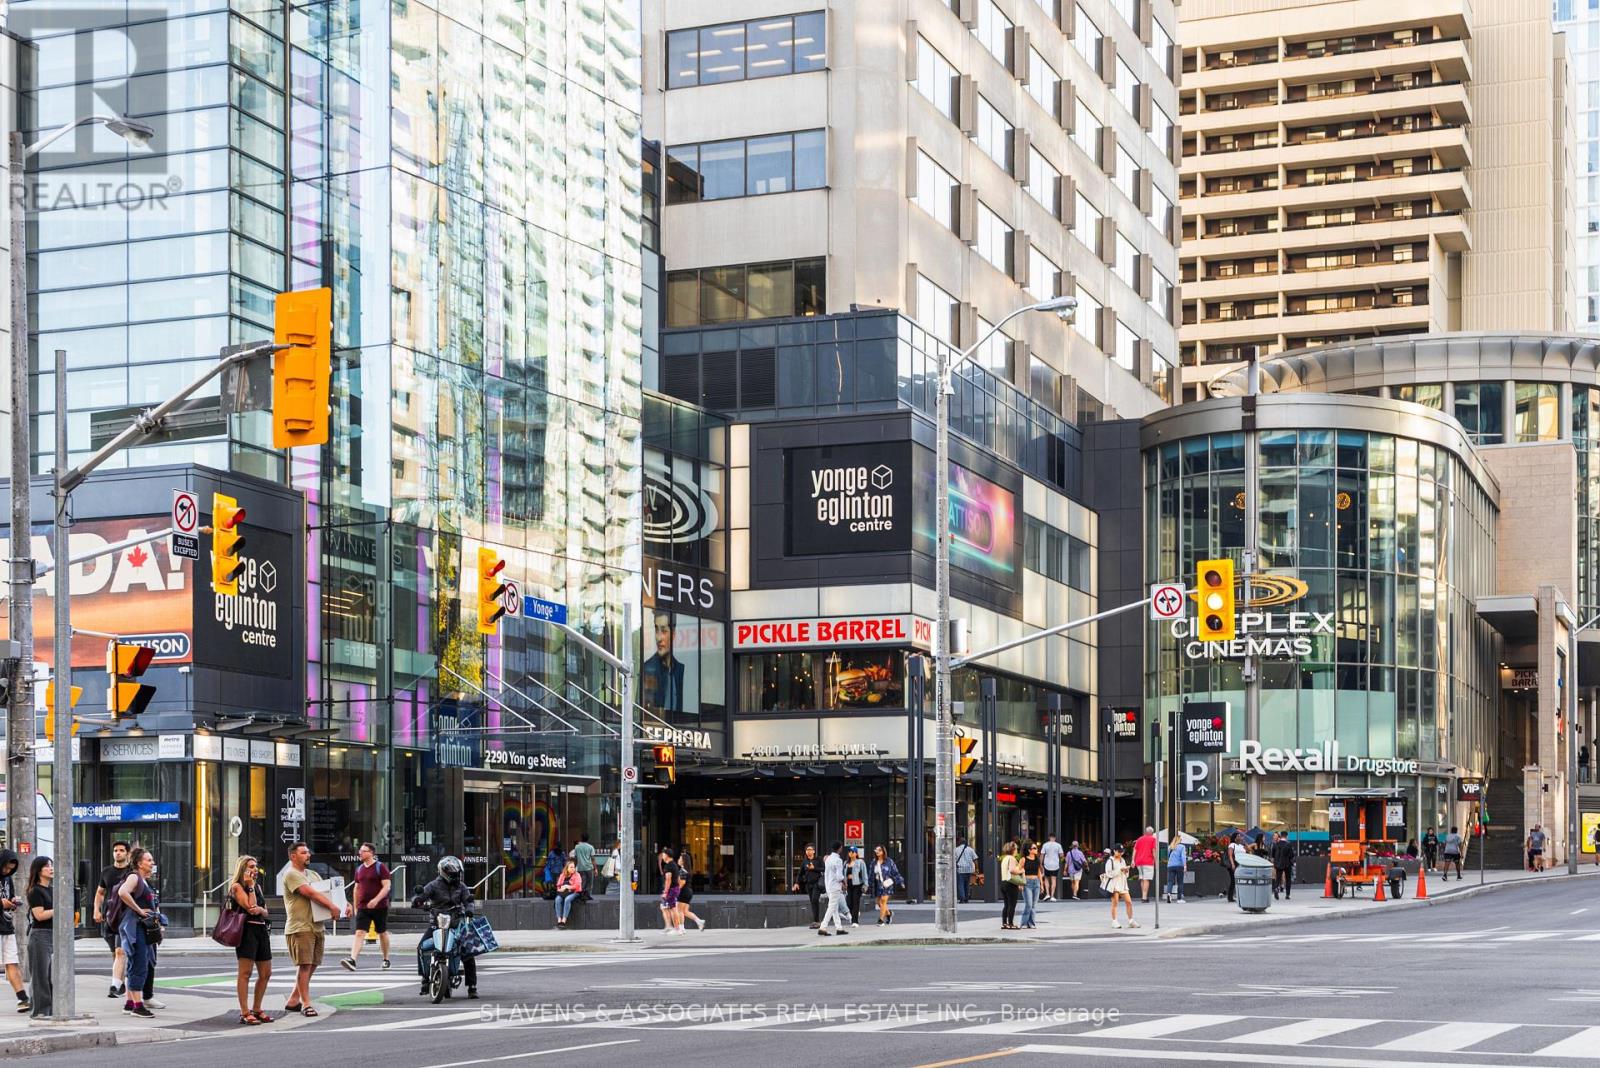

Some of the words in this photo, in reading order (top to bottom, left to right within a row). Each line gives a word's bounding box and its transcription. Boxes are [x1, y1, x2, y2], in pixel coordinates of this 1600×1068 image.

[811, 467, 868, 498] yonge
[817, 491, 893, 526] eglinton
[849, 518, 893, 532] centre
[177, 537, 194, 547] BUSES
[173, 545, 198, 557] EXCEPTED
[215, 592, 277, 630] eglinton
[532, 599, 554, 620] Yonge
[242, 630, 277, 648] centre
[738, 623, 810, 645] PICKLE
[817, 619, 906, 643] BARREL
[1186, 637, 1313, 659] CINEMAS
[1186, 718, 1212, 732] yonge
[645, 726, 712, 750] SEPHORA
[1189, 730, 1224, 744] eglinton
[112, 743, 154, 757] SERVICES
[751, 744, 780, 757] 2300
[787, 743, 826, 757] YONGE
[834, 743, 878, 756] TOWER
[484, 749, 508, 764] 2290
[539, 753, 567, 769] Street
[1240, 740, 1340, 775] Rexall
[1347, 755, 1418, 777] Drugstore
[1186, 760, 1209, 792] P
[1462, 784, 1480, 794] VIP
[94, 803, 122, 818] eglinton
[340, 855, 378, 863] WINNS
[400, 855, 431, 863] WINNERS
